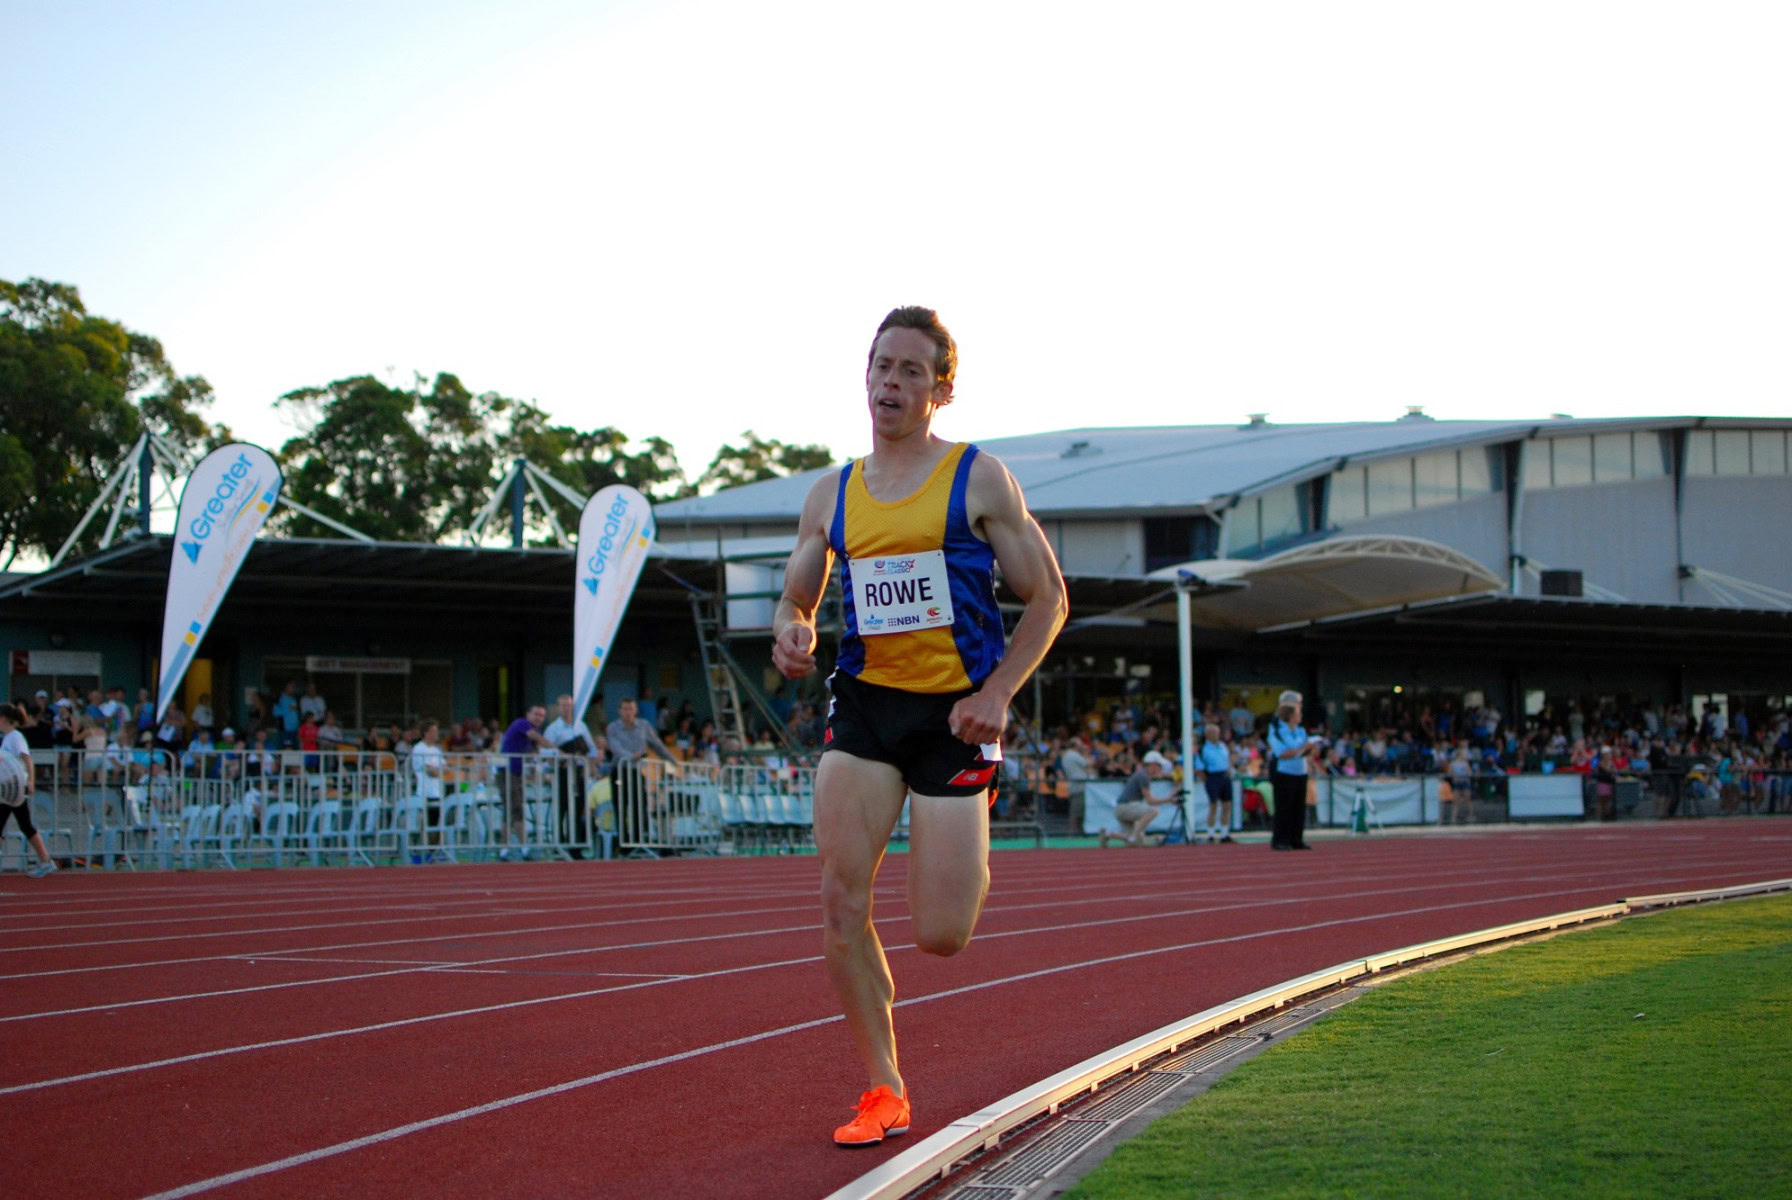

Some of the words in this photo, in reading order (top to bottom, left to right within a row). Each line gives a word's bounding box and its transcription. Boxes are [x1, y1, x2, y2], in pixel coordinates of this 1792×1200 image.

[190, 452, 254, 541] Greater
[588, 493, 629, 574] Greater
[865, 577, 933, 607] ROWE
[897, 615, 920, 626] NBN
